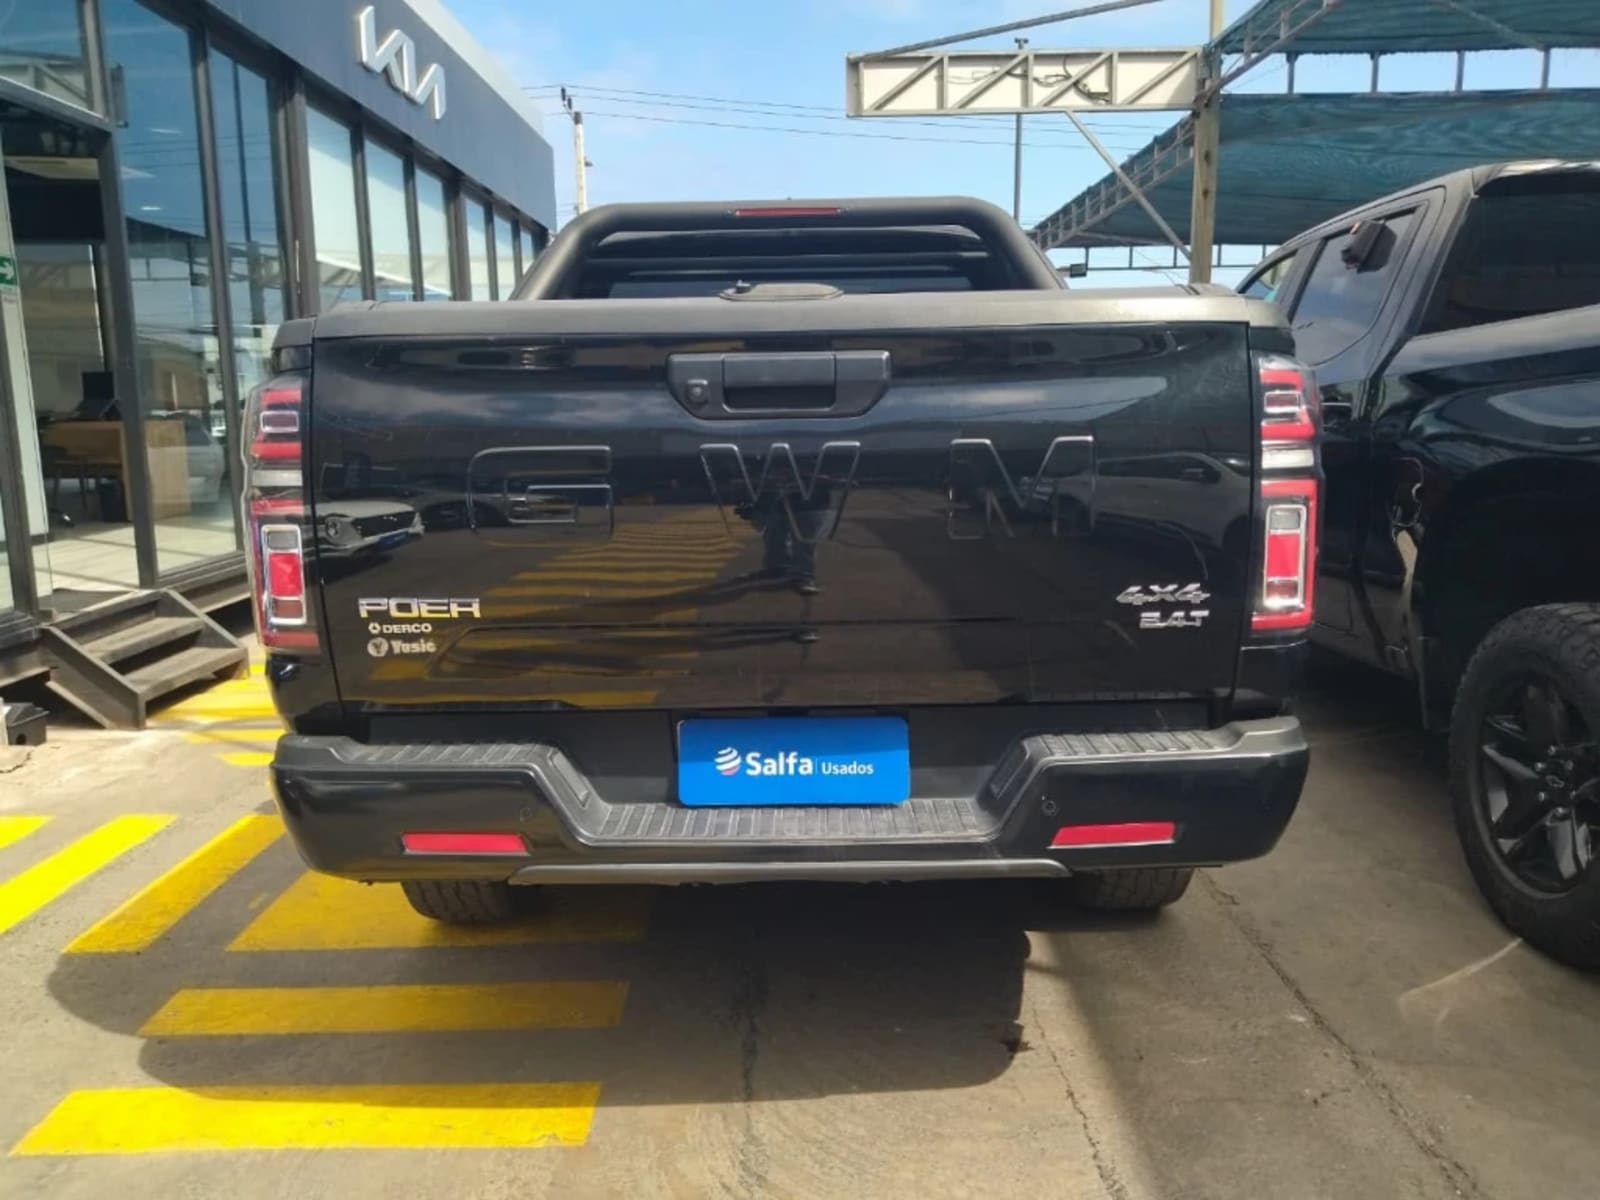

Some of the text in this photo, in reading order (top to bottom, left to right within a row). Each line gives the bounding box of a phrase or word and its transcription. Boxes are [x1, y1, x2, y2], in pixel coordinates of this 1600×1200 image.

[467, 436, 1095, 543] GWM
[357, 597, 481, 618] POER
[382, 622, 432, 634] DERCO
[745, 752, 875, 776] Salfa Usados
